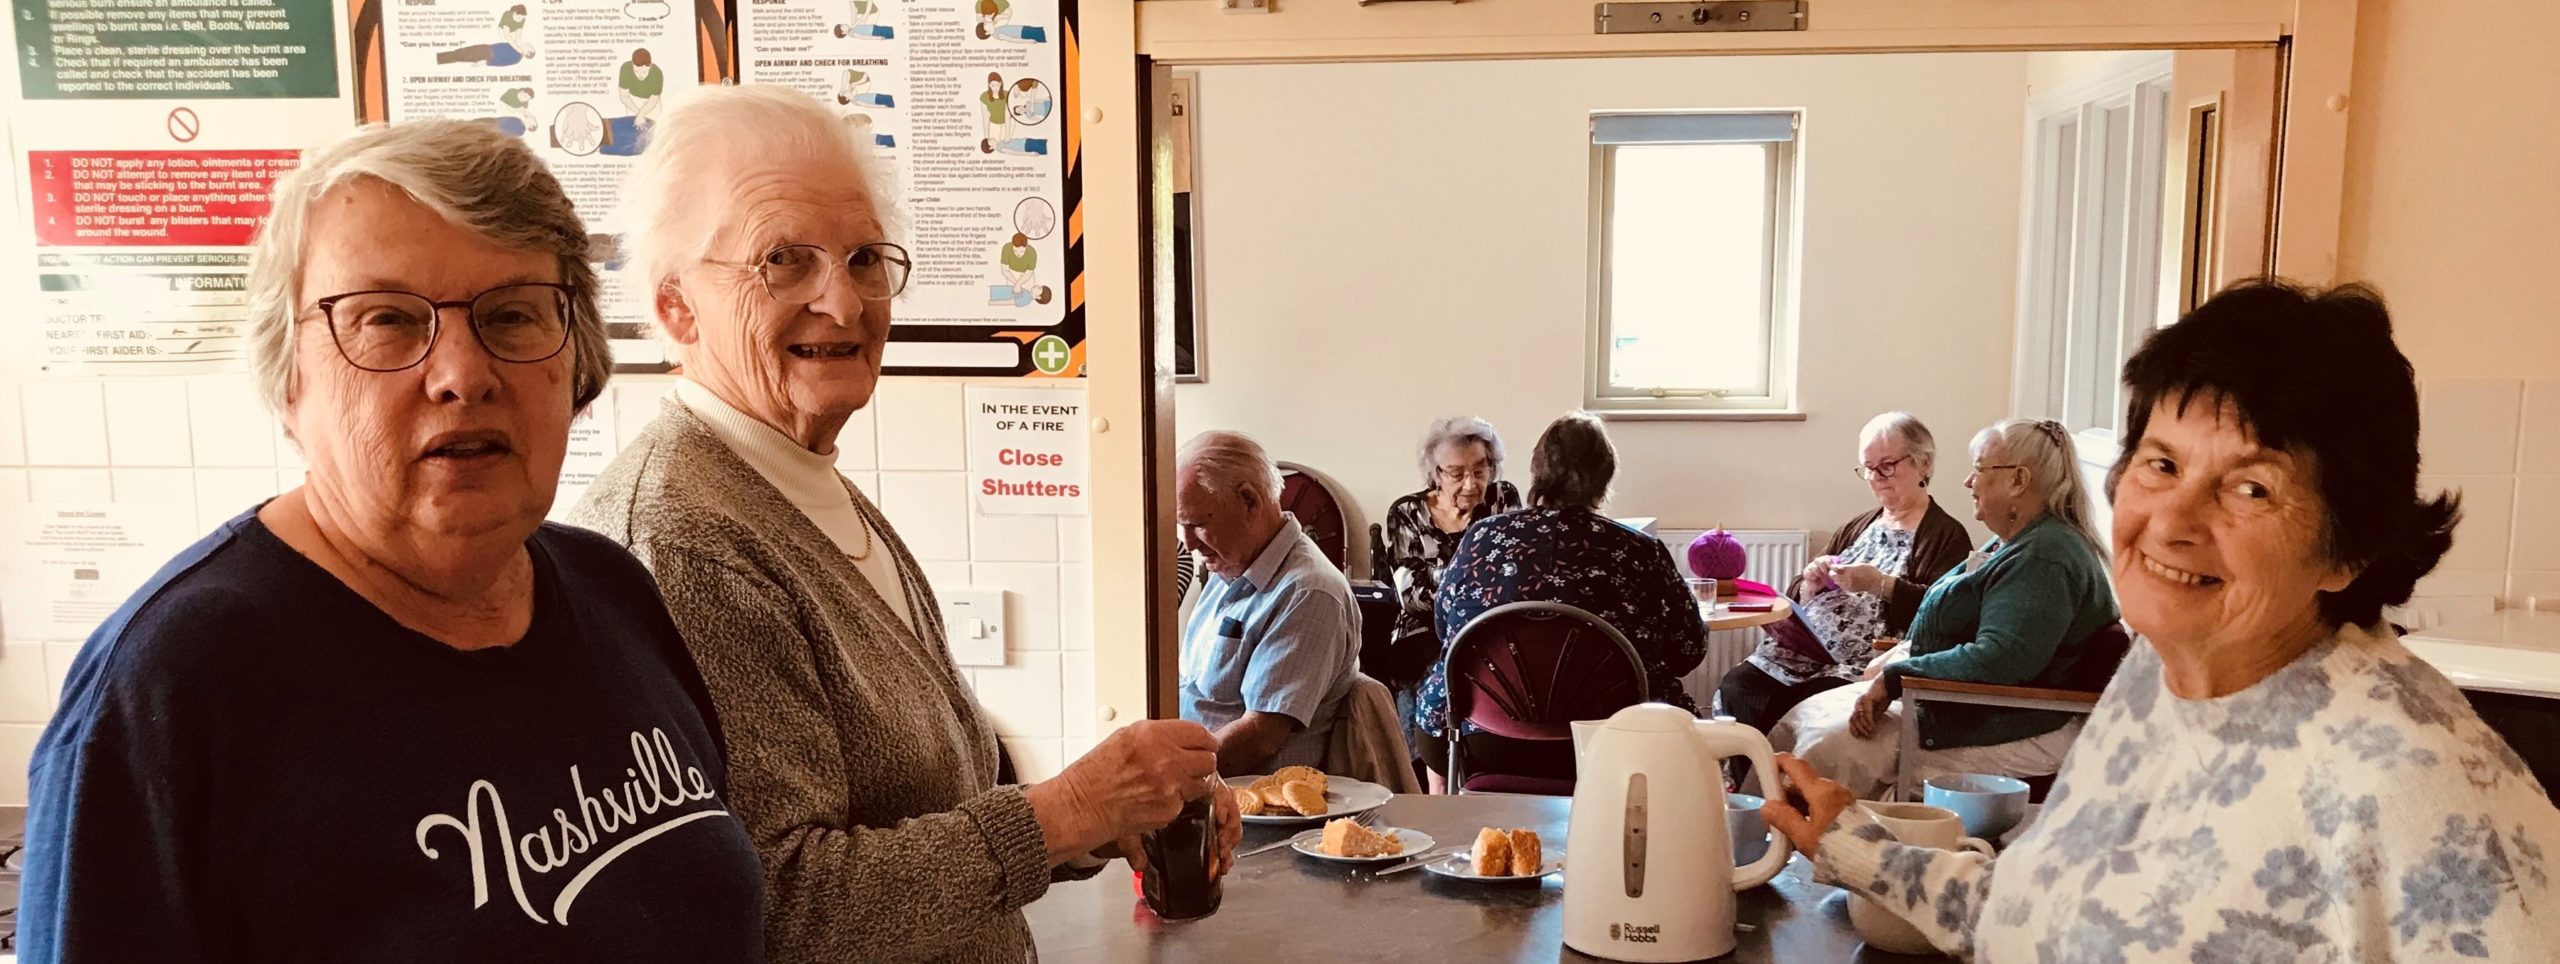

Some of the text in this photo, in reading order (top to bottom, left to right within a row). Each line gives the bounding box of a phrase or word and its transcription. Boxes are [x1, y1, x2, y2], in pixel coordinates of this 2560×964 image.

[61, 10, 104, 21] possible
[107, 11, 145, 19] remove
[147, 11, 166, 21] any
[169, 9, 197, 18] items
[200, 9, 220, 18] that
[222, 11, 243, 20] may
[246, 9, 286, 20] prevent
[51, 22, 94, 33] swelling
[97, 23, 107, 31] to
[110, 22, 138, 31] burnt
[140, 23, 163, 31] area
[245, 20, 290, 30] Watches
[52, 34, 100, 45] or Rings.
[54, 45, 83, 55] Place
[85, 47, 91, 55] a
[127, 46, 159, 55] sterile
[162, 45, 206, 56] dressing
[234, 45, 250, 54] the
[253, 45, 280, 54] burnt
[283, 46, 306, 54] area
[55, 58, 88, 67] Check
[90, 58, 110, 67] that
[123, 58, 165, 69] required
[183, 57, 239, 66] ambulance
[242, 57, 260, 66] has
[262, 57, 288, 66] been
[56, 69, 278, 79] called and check that the accident has been
[57, 82, 101, 92] reported
[104, 82, 115, 91] to
[118, 82, 134, 90] the
[136, 82, 173, 90] correct
[72, 158, 88, 168] DO
[91, 158, 113, 167] NOT
[116, 158, 144, 169] apply
[147, 159, 165, 169] any
[202, 158, 252, 167] ointments
[254, 159, 265, 167] or
[73, 170, 89, 179] DO
[91, 170, 114, 179] NOT
[117, 170, 155, 181] attempt
[158, 170, 168, 178] to
[211, 171, 229, 180] any
[232, 169, 253, 178] item
[256, 169, 266, 178] of
[74, 182, 93, 190] that
[96, 183, 117, 191] may
[120, 182, 132, 190] be
[135, 181, 174, 192] sticking
[178, 182, 187, 190] to
[190, 181, 206, 190] the
[209, 181, 236, 190] burnt
[75, 193, 90, 202] DO
[93, 193, 115, 202] NOT
[118, 193, 146, 202] touch
[149, 194, 159, 202] or
[162, 193, 190, 204] place
[192, 193, 237, 204] anything
[239, 192, 265, 202] other
[75, 204, 106, 213] sterile
[108, 203, 152, 215] dressing
[76, 216, 92, 225] DO
[94, 216, 116, 225] NOT
[119, 216, 145, 225] burst
[150, 217, 168, 227] any
[171, 215, 208, 225] blisters
[211, 215, 232, 225] that
[234, 217, 256, 227] may
[76, 227, 112, 237] around
[114, 227, 130, 237] the
[103, 255, 135, 263] ACTION
[137, 255, 154, 263] CAN
[156, 255, 195, 263] PREVENT
[197, 255, 235, 263] SERIOUS
[96, 330, 125, 339] FIRST
[113, 346, 143, 355] AIDER
[982, 403, 1078, 415] IN THE EVENT
[996, 421, 1064, 431] OF A FIRE
[999, 448, 1063, 466] Close
[982, 478, 1080, 497] Shutters
[416, 727, 718, 924] Nashville
[1624, 923, 1660, 933] Russell
[1624, 932, 1657, 943] Hobbs
